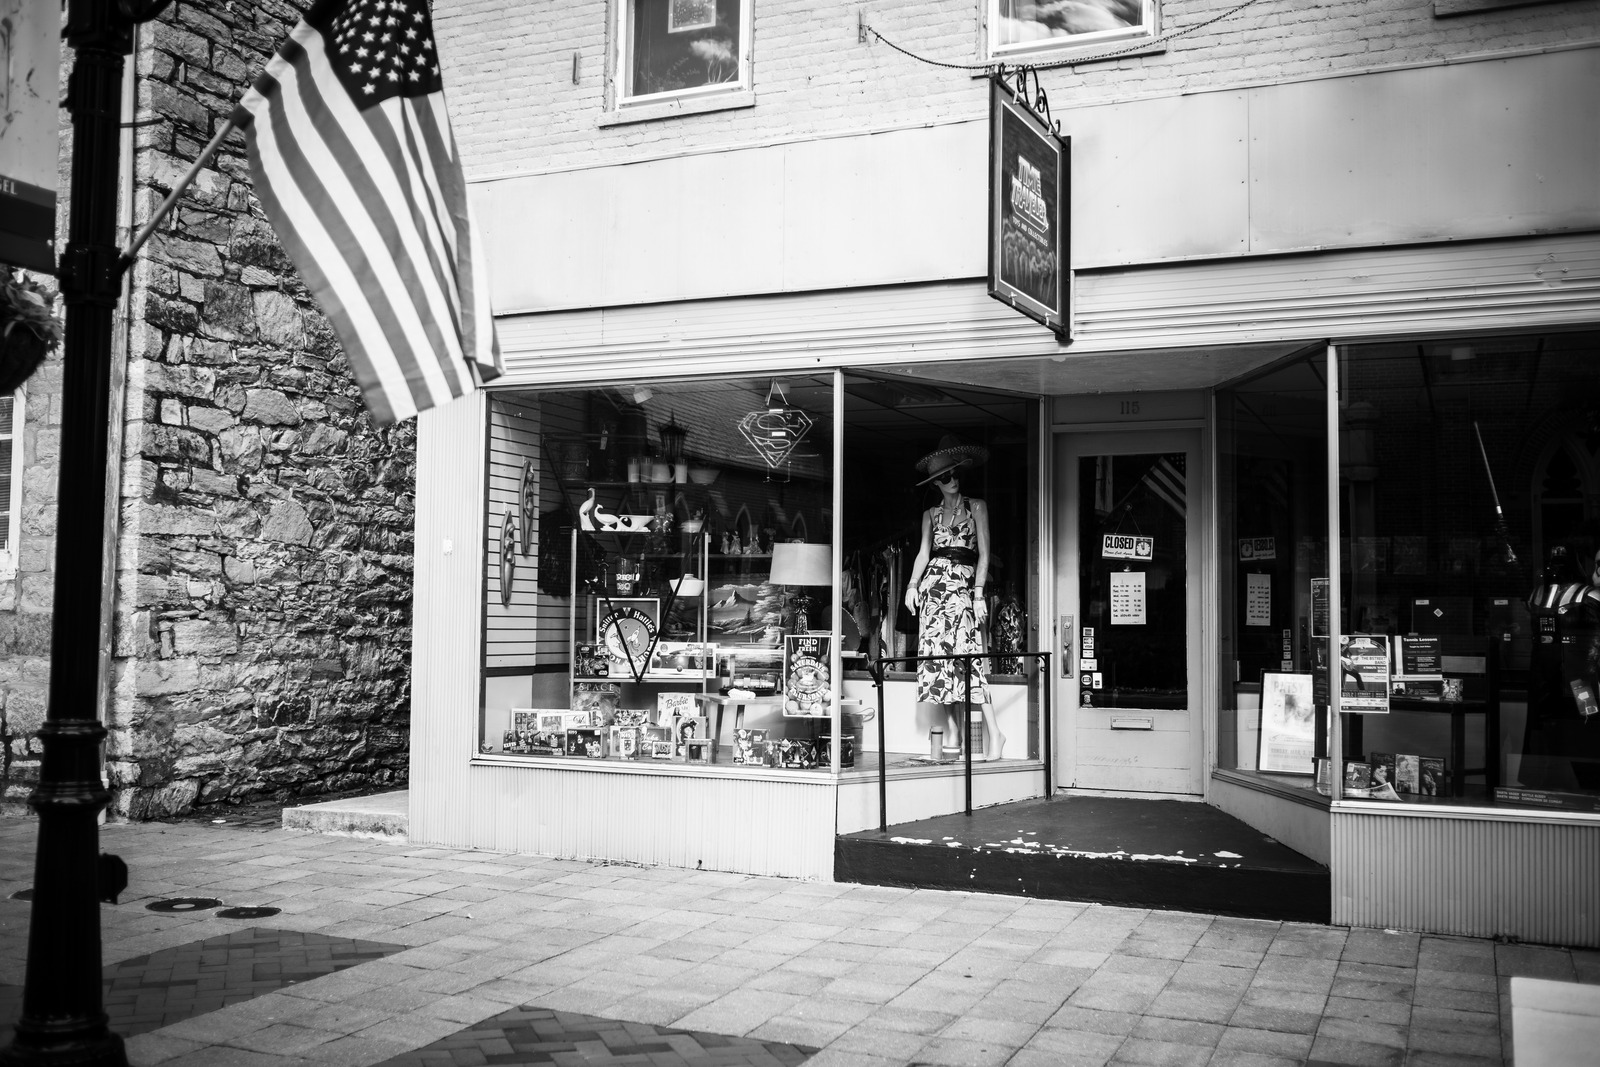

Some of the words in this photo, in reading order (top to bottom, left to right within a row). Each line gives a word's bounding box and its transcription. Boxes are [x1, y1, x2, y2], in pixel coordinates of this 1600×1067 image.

[1018, 155, 1042, 198] TIME
[1011, 174, 1048, 226] TRAVELER
[1120, 401, 1140, 415] 115
[1105, 536, 1134, 550] CLOSED
[798, 638, 818, 646] FIND
[790, 659, 827, 672] SATURDAYS
[579, 682, 616, 692] SPACE
[665, 696, 689, 709] Barbie
